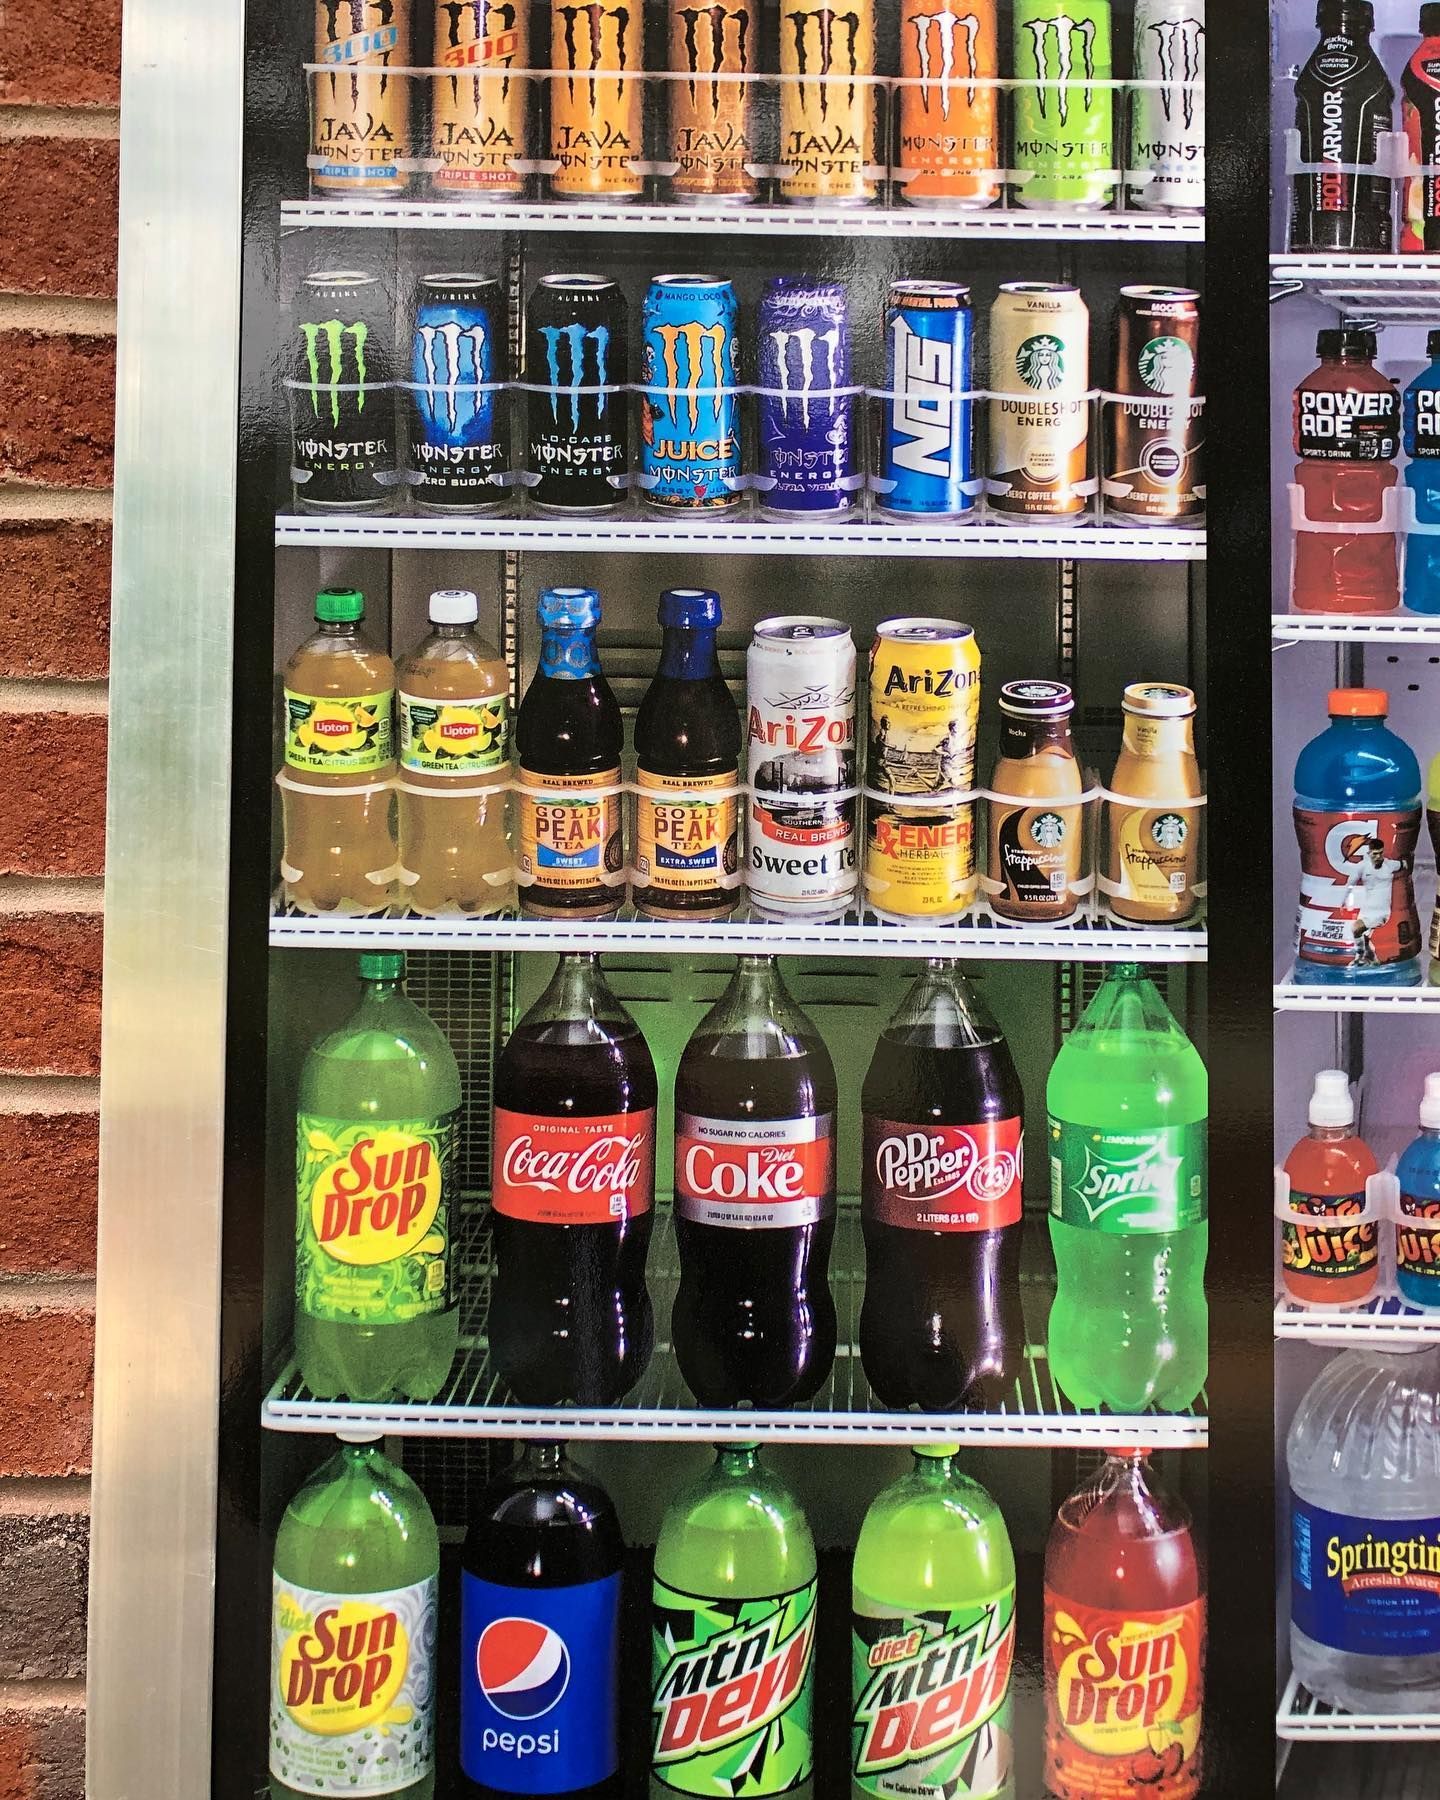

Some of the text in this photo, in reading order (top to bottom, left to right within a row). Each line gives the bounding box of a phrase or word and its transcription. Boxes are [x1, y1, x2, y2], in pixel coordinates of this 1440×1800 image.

[321, 26, 398, 63] 300
[443, 32, 520, 68] 300
[319, 112, 394, 143] JAVA
[439, 117, 515, 147] JAVA
[556, 120, 632, 151] JAVA
[676, 122, 750, 152] JAVA
[787, 125, 861, 156] JAVA
[902, 134, 994, 156] MONSTER
[1017, 139, 1110, 158] MONSTER
[439, 170, 512, 182] TRIPLE SHOT
[664, 292, 731, 301] MANGO LOCO
[1027, 300, 1062, 309] VANILLA
[1302, 391, 1393, 416] POWER
[1302, 414, 1353, 438] ADE
[296, 438, 388, 460] MONSTER
[412, 442, 503, 463] MONSTER
[530, 443, 624, 465] MONSTER
[653, 438, 734, 461] JUICE
[1303, 449, 1351, 458] SPORTS DRINK
[304, 461, 376, 471] ENERGY
[420, 464, 493, 475] ENERGY
[539, 465, 613, 476] ENERGY
[650, 465, 737, 485] MONSTER
[770, 469, 843, 480] ENERGY
[316, 722, 349, 733] Lipton
[443, 727, 477, 738] Lipton
[288, 751, 307, 763] GREEN
[308, 756, 323, 766] TEA
[421, 761, 444, 770] GREEN
[535, 806, 600, 818] GOLD
[655, 807, 718, 819] GOLD
[536, 817, 600, 841] PEAK
[655, 818, 719, 842] PEAK
[776, 829, 807, 841] REAL
[552, 841, 584, 849] TEA
[671, 842, 702, 850] TEA
[901, 850, 944, 859] HERBAL
[555, 857, 583, 865] SWEET
[660, 857, 715, 865] EXTRA SWEET
[752, 846, 828, 875] Sweet
[1125, 843, 1187, 870] frappuccino
[1311, 930, 1343, 939] QUENCHER
[1322, 925, 1344, 933] THIRST
[533, 1124, 613, 1134] ORIGINAL TASTE
[698, 1127, 785, 1138] NO SUGAR NO CALORIES
[761, 1147, 795, 1163] Diet
[907, 1133, 945, 1161] Dr
[332, 1139, 431, 1194] Sun
[503, 1132, 645, 1193] Coca-Cola
[686, 1145, 804, 1198] Coke
[319, 1182, 426, 1242] Drop
[917, 1213, 922, 1221] 2
[924, 1213, 949, 1223] LITERS
[1351, 1576, 1440, 1589] Artesian Water
[280, 1609, 312, 1630] diet
[298, 1609, 397, 1664] Sun
[872, 1633, 920, 1662] diet
[1078, 1630, 1175, 1683] Sun
[658, 1628, 770, 1701] Mtn
[864, 1634, 978, 1710] Mtn
[286, 1653, 392, 1708] Drop
[1065, 1674, 1173, 1728] Drop
[483, 1728, 559, 1759] pepsi
[882, 1780, 894, 1789] Low
